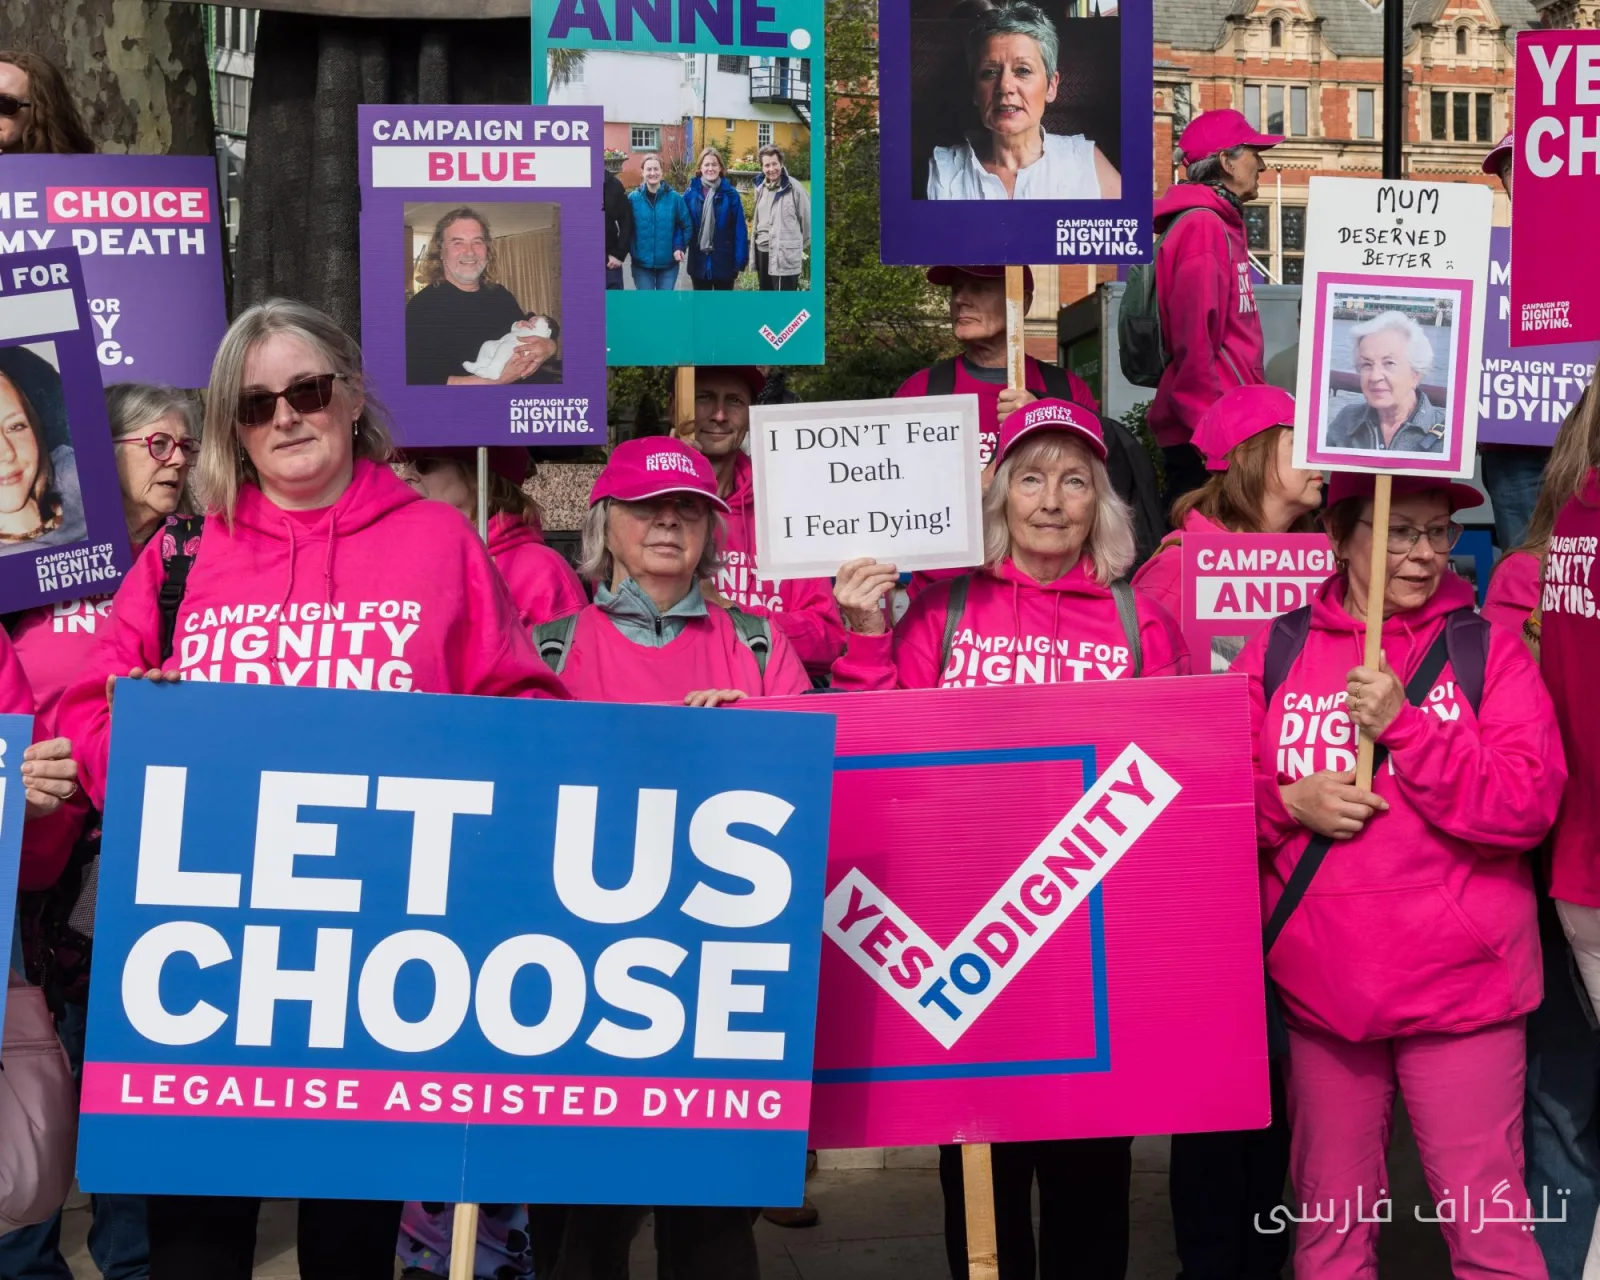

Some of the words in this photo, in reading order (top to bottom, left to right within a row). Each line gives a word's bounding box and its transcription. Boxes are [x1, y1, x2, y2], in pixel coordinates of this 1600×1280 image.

[1528, 44, 1600, 106] YE
[373, 120, 523, 141] CAMPAIGN
[534, 120, 589, 141] FOR
[428, 152, 536, 181] BLUE
[53, 190, 204, 218] CHOICE
[1377, 186, 1439, 214] MUM
[1056, 219, 1113, 228] CAMPAIGN
[1116, 219, 1138, 227] FOR
[1056, 227, 1138, 242] DIGNITY
[72, 228, 205, 255] DEATH
[1338, 227, 1446, 246] DESERVED
[1056, 241, 1076, 256] IN
[1079, 241, 1144, 256] DYING.
[1362, 248, 1431, 268] BETTER
[12, 263, 69, 289] FOR
[87, 298, 120, 313] OR
[1521, 302, 1555, 310] CAMPAIGN
[1521, 308, 1569, 321] DIGNITY
[762, 327, 776, 342] YES
[1521, 320, 1533, 331] IN
[1535, 318, 1573, 330] DYING.
[1480, 358, 1555, 375] MPAIGN
[1483, 372, 1592, 400] IGNIT
[510, 399, 564, 407] CAMPAIGN
[568, 398, 589, 406] FOR
[510, 406, 589, 420] DIGNITY
[1497, 397, 1573, 424] DYIN
[510, 420, 529, 433] IN
[532, 420, 595, 433] DYING.
[769, 430, 779, 451] I
[905, 422, 960, 443] Fear
[784, 516, 793, 538] I
[805, 515, 860, 537] Fear
[868, 506, 951, 538] Dying!
[35, 547, 89, 565] CAMPAIGN
[92, 543, 113, 554] FOR
[1577, 536, 1598, 555] FOR
[36, 551, 113, 579] DIGNITY
[39, 577, 59, 593] IN
[60, 565, 122, 588] DYING.
[53, 614, 96, 634] IN
[184, 602, 345, 633] CAMPAIGN
[359, 600, 422, 621] FOR
[179, 621, 420, 669] DIGNITY
[1079, 642, 1129, 664] FOR
[135, 765, 494, 916] LET
[552, 784, 796, 928] US
[837, 885, 935, 990] YES
[121, 921, 791, 1060] CHOOSE
[120, 1073, 359, 1110] LEGALISE
[384, 1081, 618, 1116] ASSISTED
[642, 1087, 782, 1120] DYING
